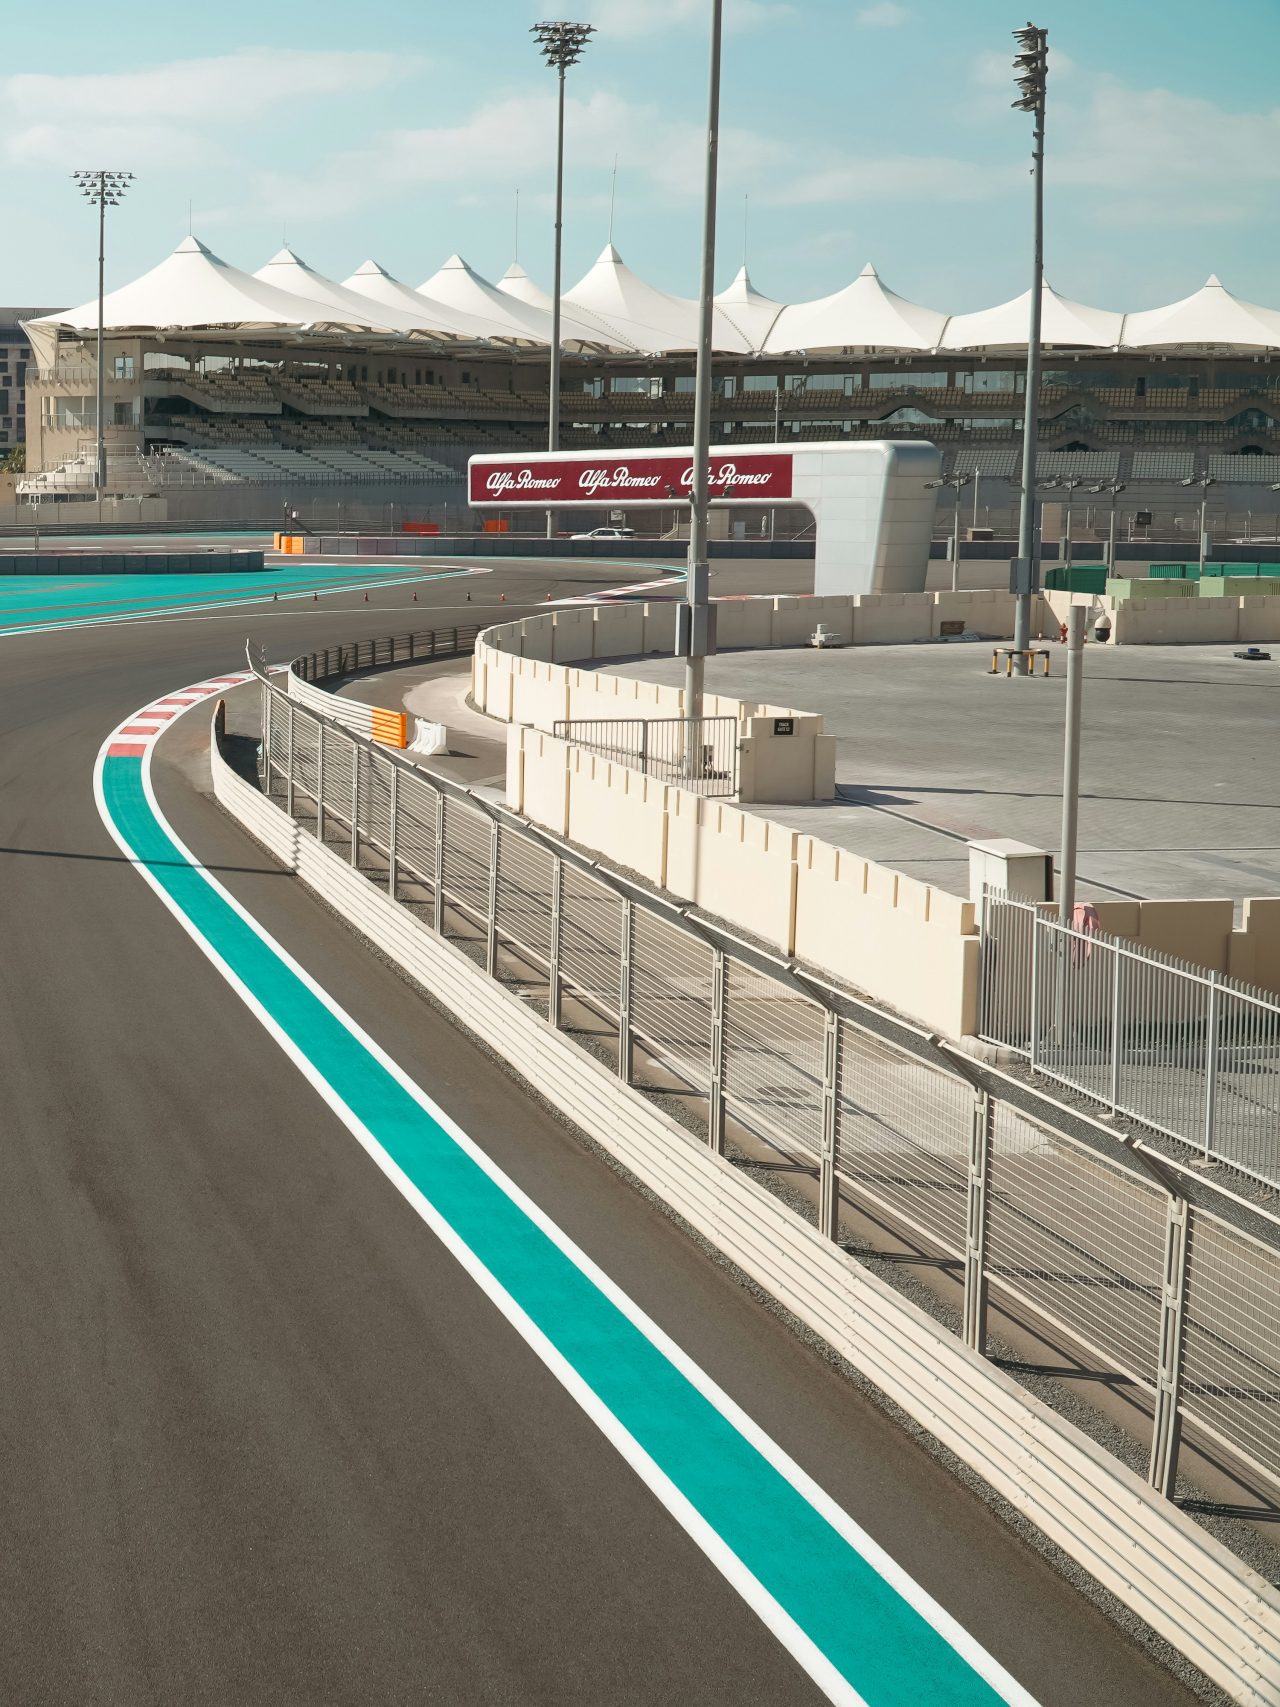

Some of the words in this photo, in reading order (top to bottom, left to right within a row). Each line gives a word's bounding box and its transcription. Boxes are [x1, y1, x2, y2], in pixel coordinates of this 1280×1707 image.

[486, 470, 516, 497] Alfa
[516, 469, 561, 489] Romeo
[578, 469, 611, 496] Alfa
[612, 466, 661, 488] Romeo
[717, 463, 773, 485] Romeo
